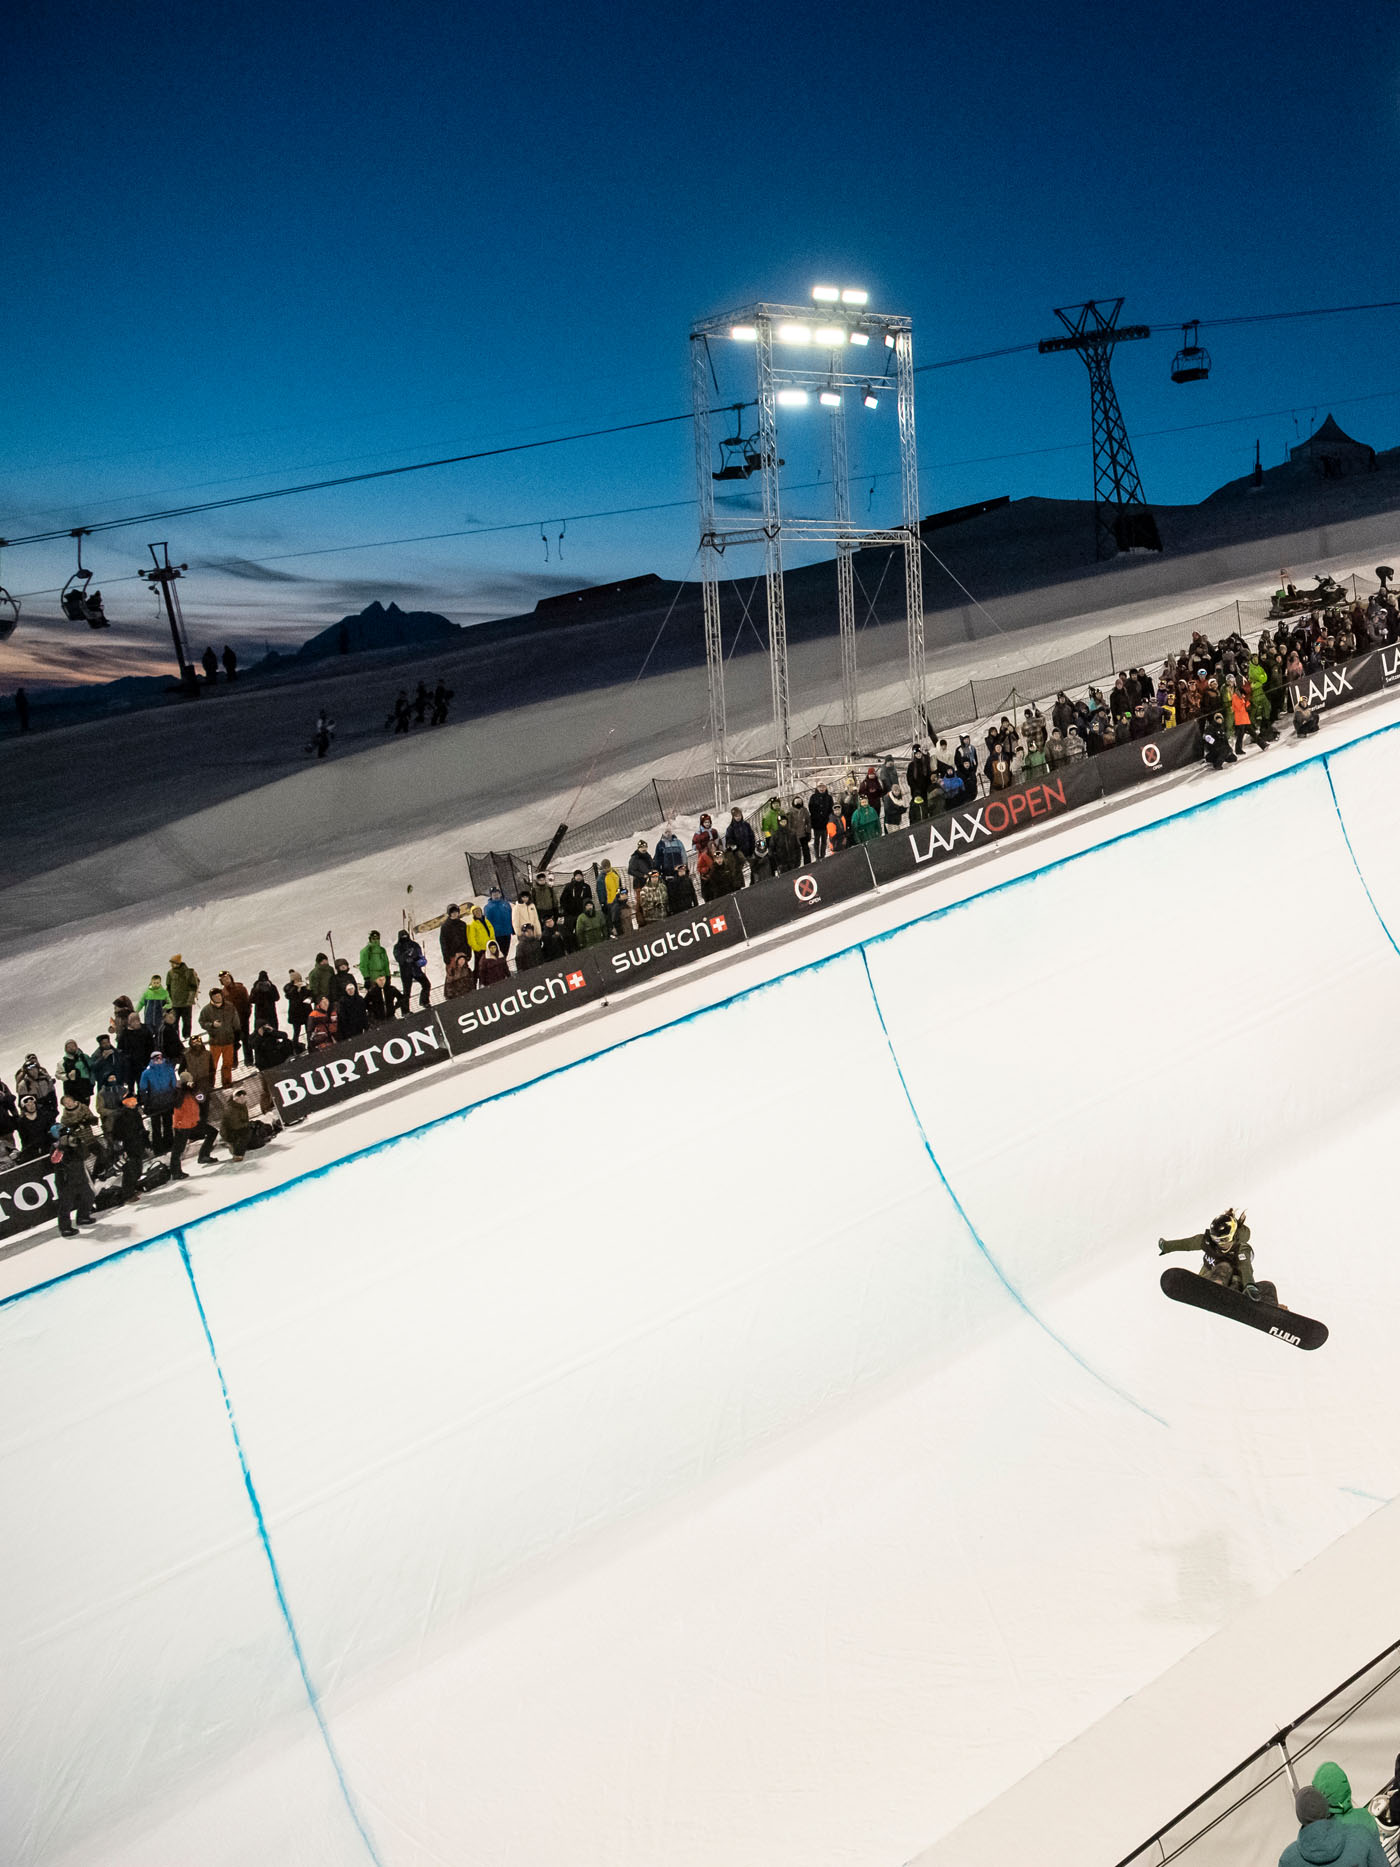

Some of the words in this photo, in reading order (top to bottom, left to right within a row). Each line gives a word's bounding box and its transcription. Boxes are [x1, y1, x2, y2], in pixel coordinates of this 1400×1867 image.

[611, 921, 711, 974] swatch
[457, 977, 567, 1034] swatch
[274, 1025, 440, 1108] BURTON
